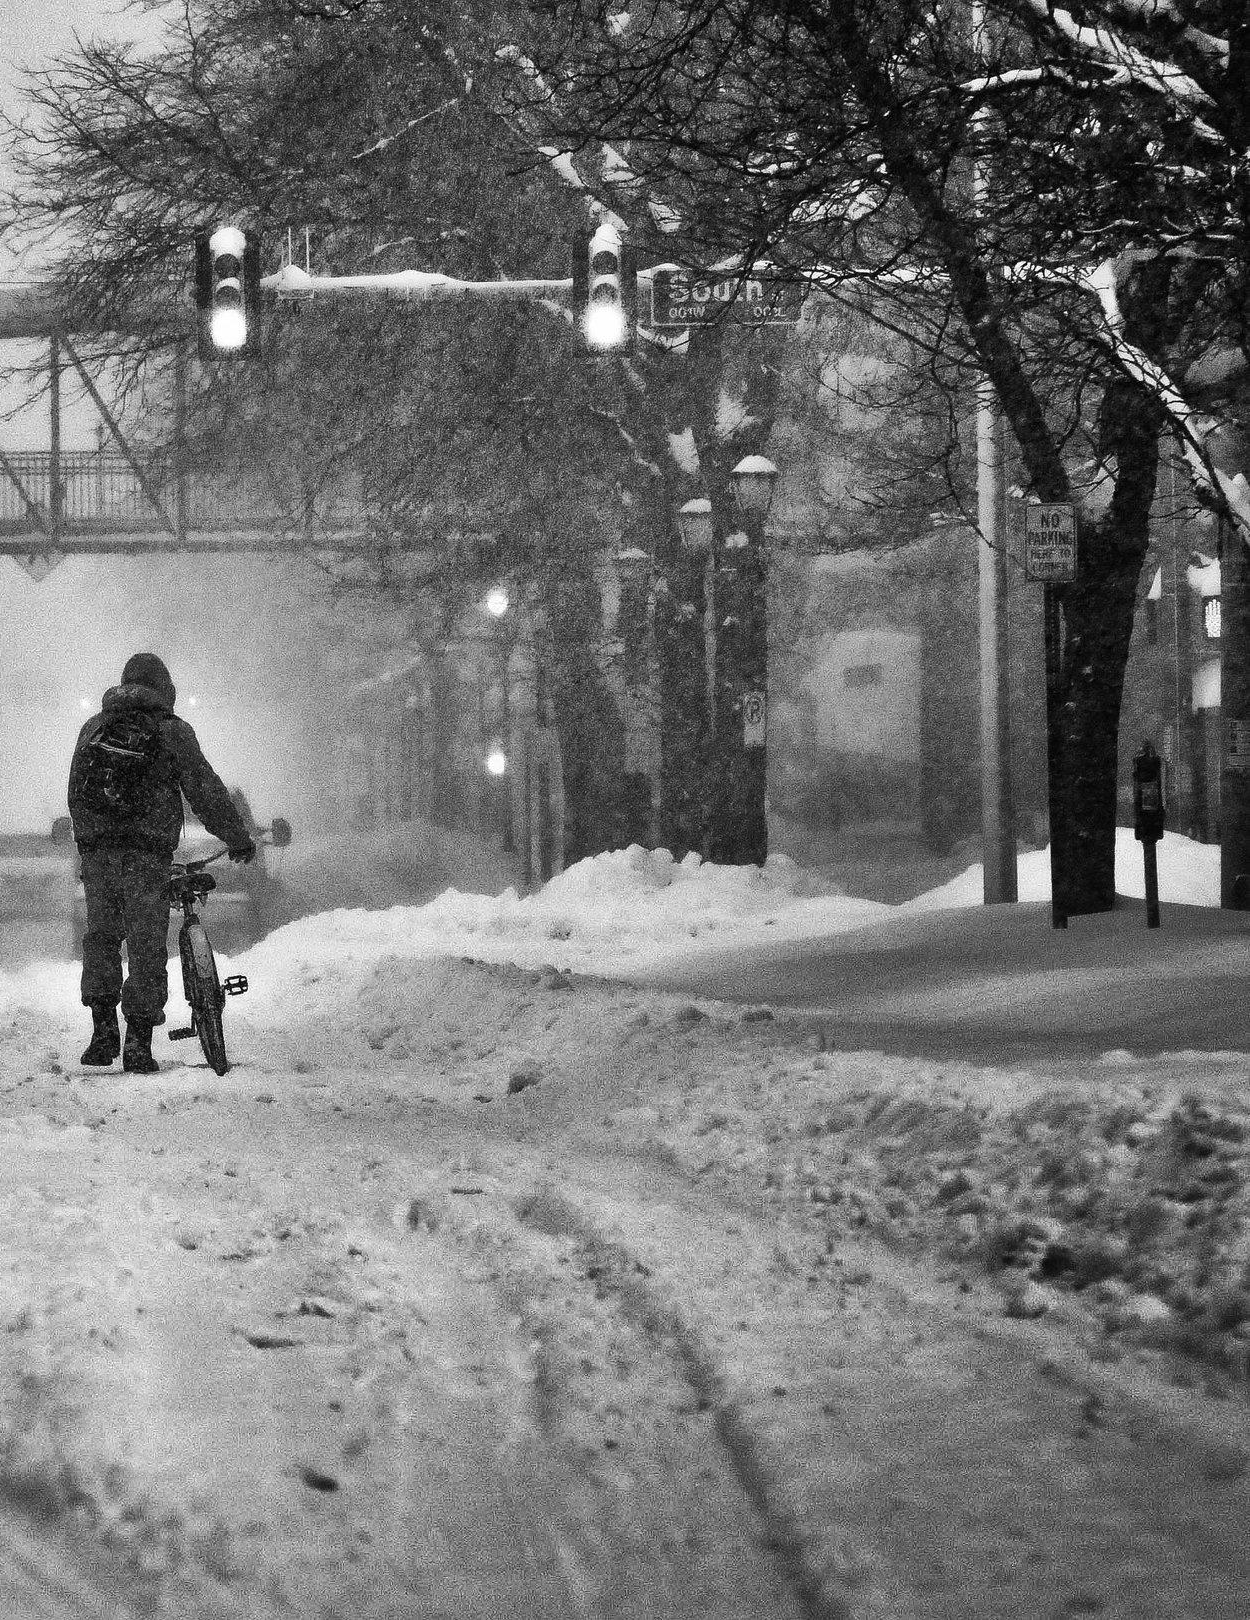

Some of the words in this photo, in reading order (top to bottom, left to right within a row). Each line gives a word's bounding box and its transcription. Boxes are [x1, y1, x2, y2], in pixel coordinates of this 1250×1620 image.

[1041, 513, 1060, 528] NO
[1028, 531, 1073, 545] PARKING
[1059, 548, 1071, 558] TO
